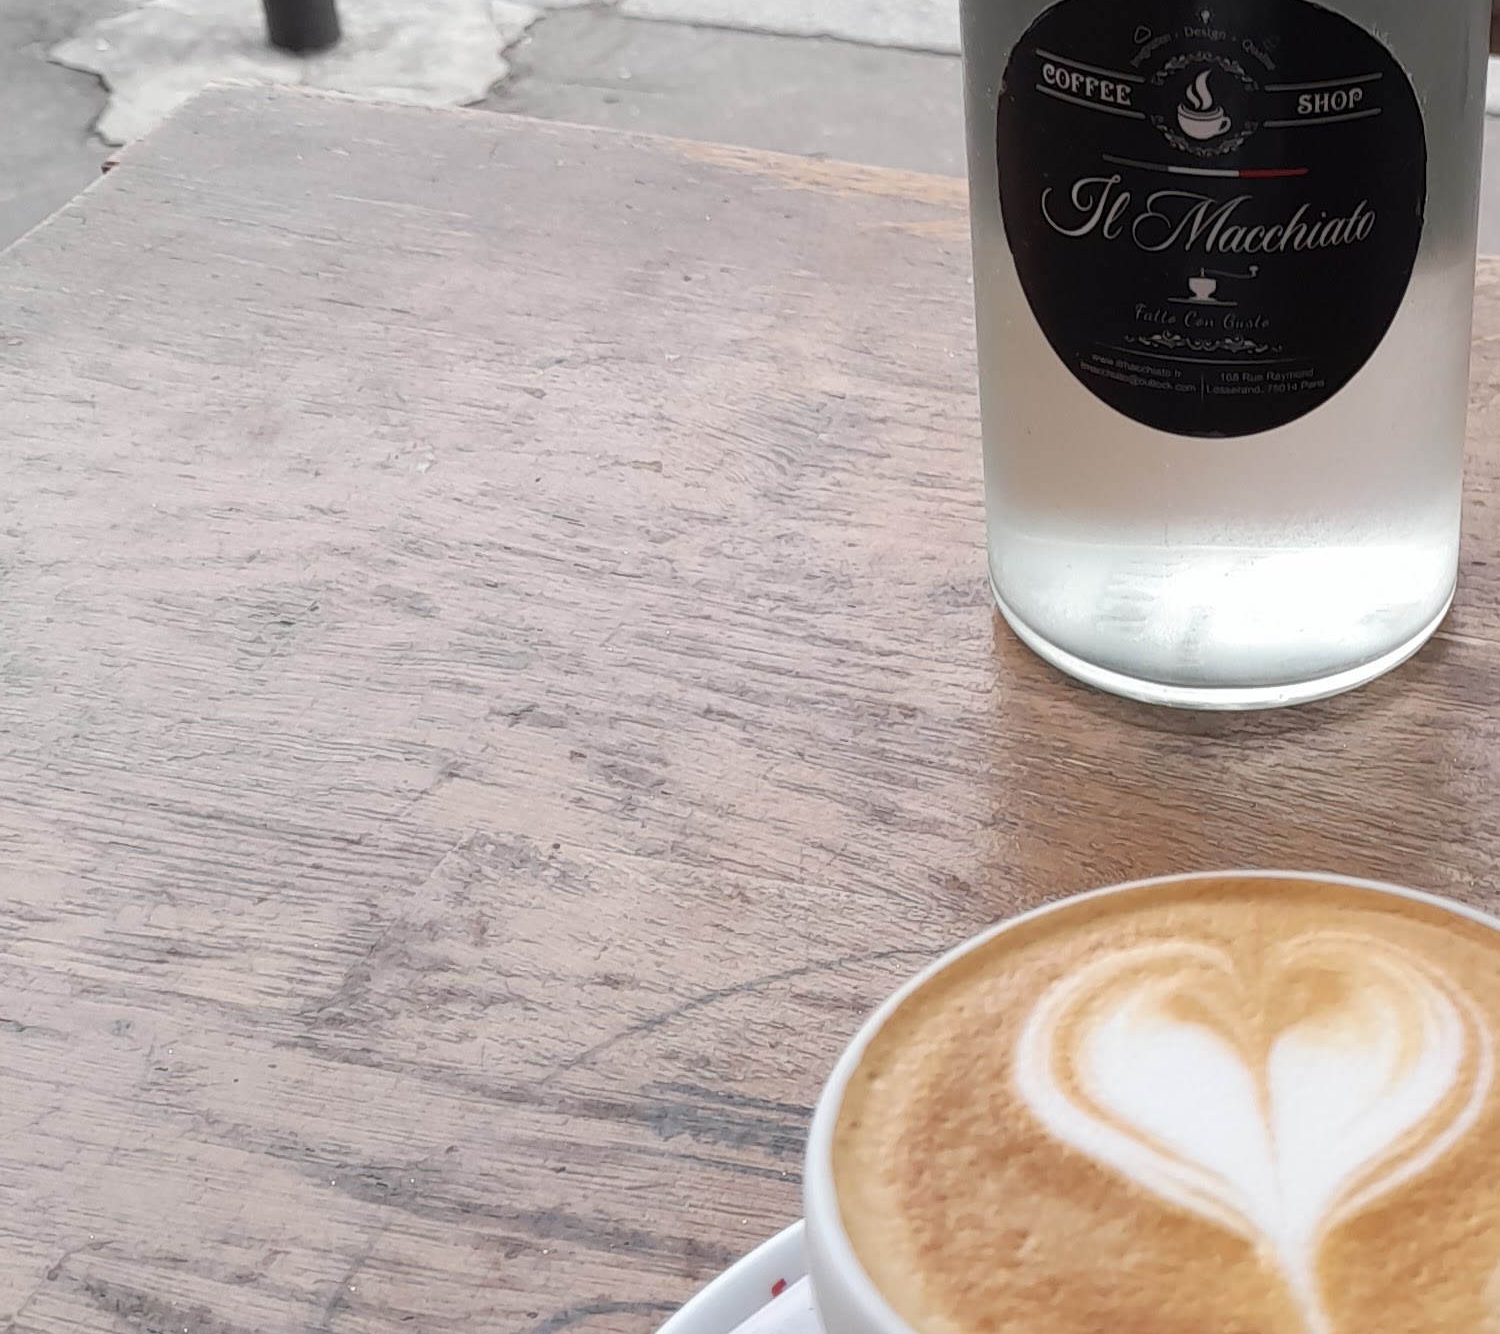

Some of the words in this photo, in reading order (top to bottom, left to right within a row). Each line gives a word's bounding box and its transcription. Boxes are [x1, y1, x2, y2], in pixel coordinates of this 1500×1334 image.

[1042, 62, 1132, 106] COFFEE
[1296, 86, 1364, 115] SHOP
[1132, 189, 1376, 254] Macchiato
[1242, 371, 1264, 383] Rue
